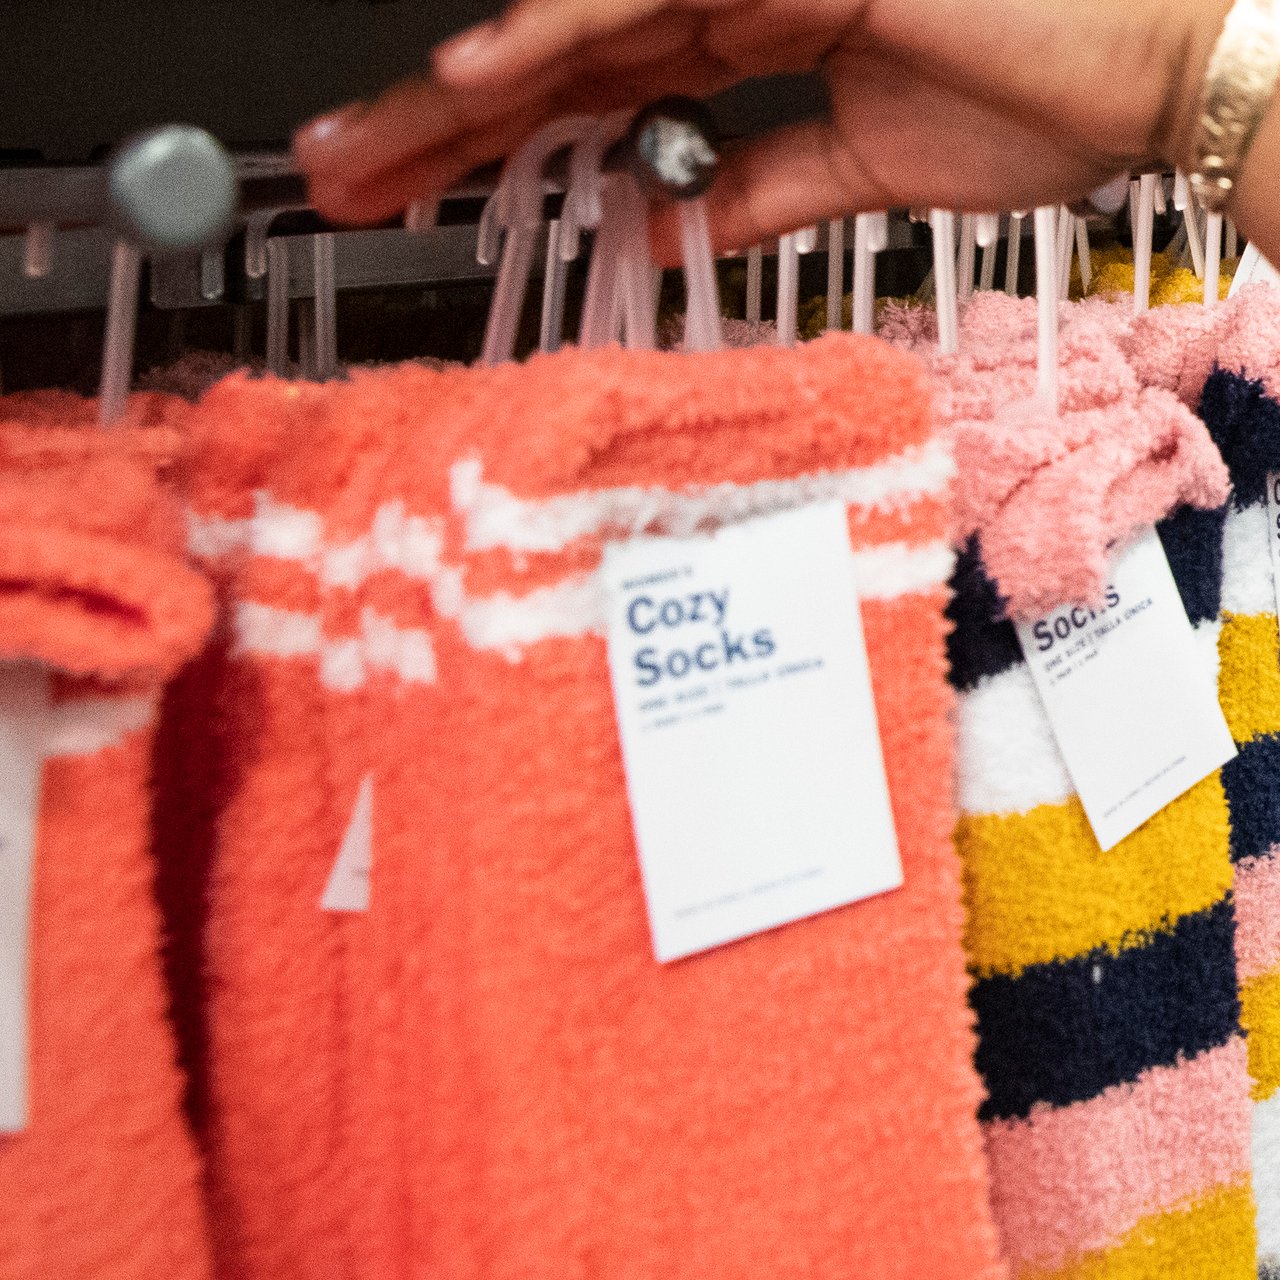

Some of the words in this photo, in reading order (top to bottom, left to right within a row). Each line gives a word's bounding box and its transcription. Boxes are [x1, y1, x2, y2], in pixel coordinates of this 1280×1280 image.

[625, 586, 730, 635] Cozy
[1032, 584, 1120, 652] Socs
[632, 627, 777, 688] Socks
